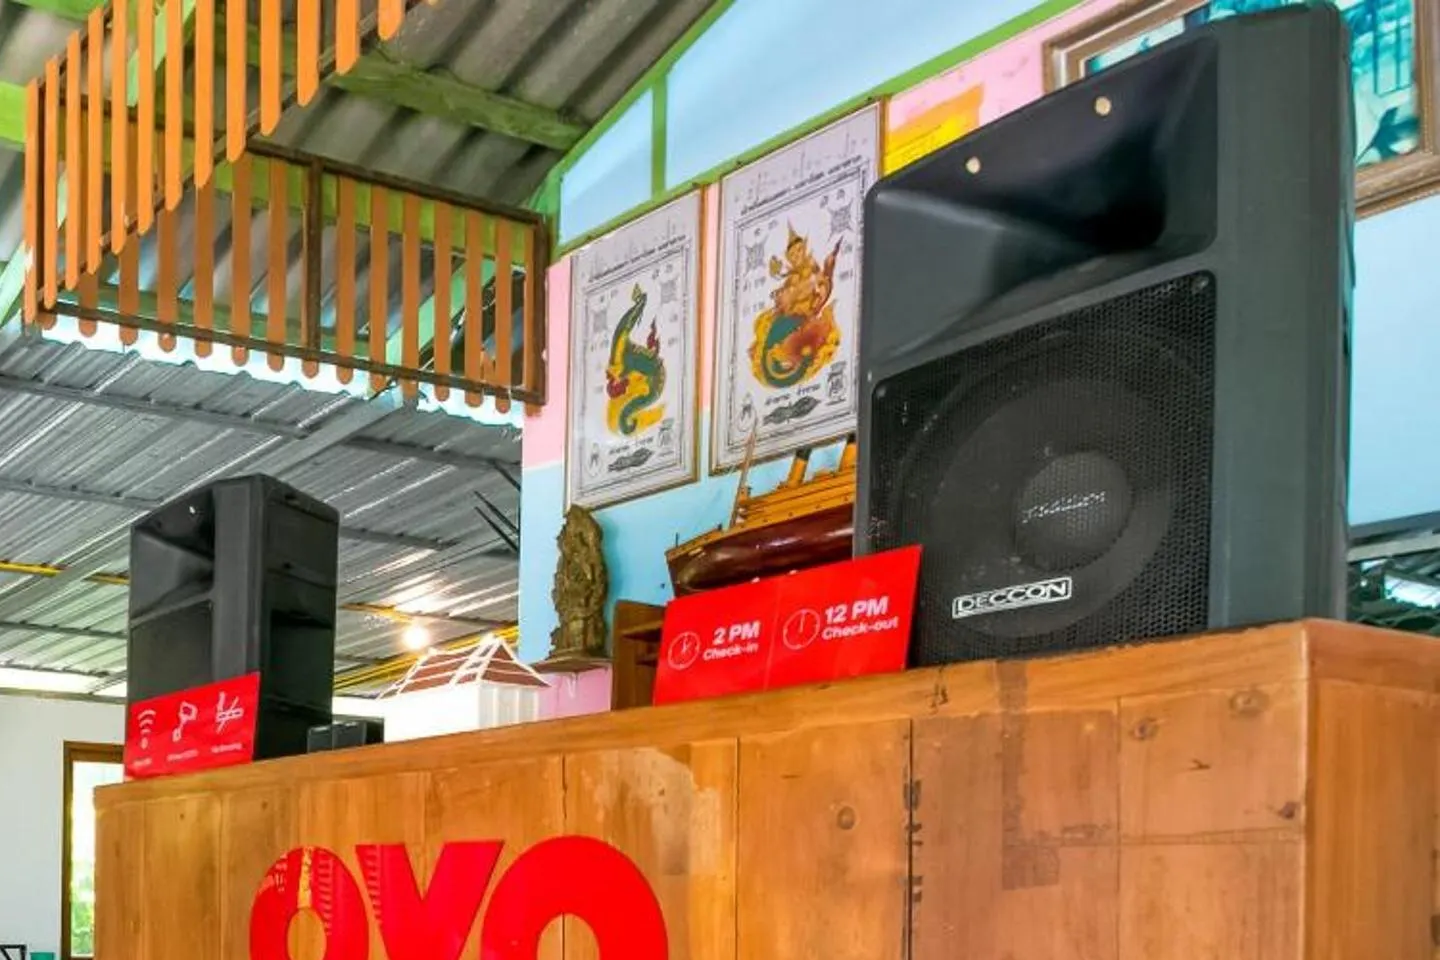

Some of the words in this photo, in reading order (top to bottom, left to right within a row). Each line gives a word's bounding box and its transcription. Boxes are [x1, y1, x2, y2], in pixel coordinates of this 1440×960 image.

[956, 580, 1067, 613] DECCON
[824, 604, 848, 625] 12
[851, 596, 890, 621] PM
[712, 627, 726, 646] 2
[728, 619, 760, 642] PM
[821, 615, 900, 640] Check-out
[702, 641, 760, 661] Check-in
